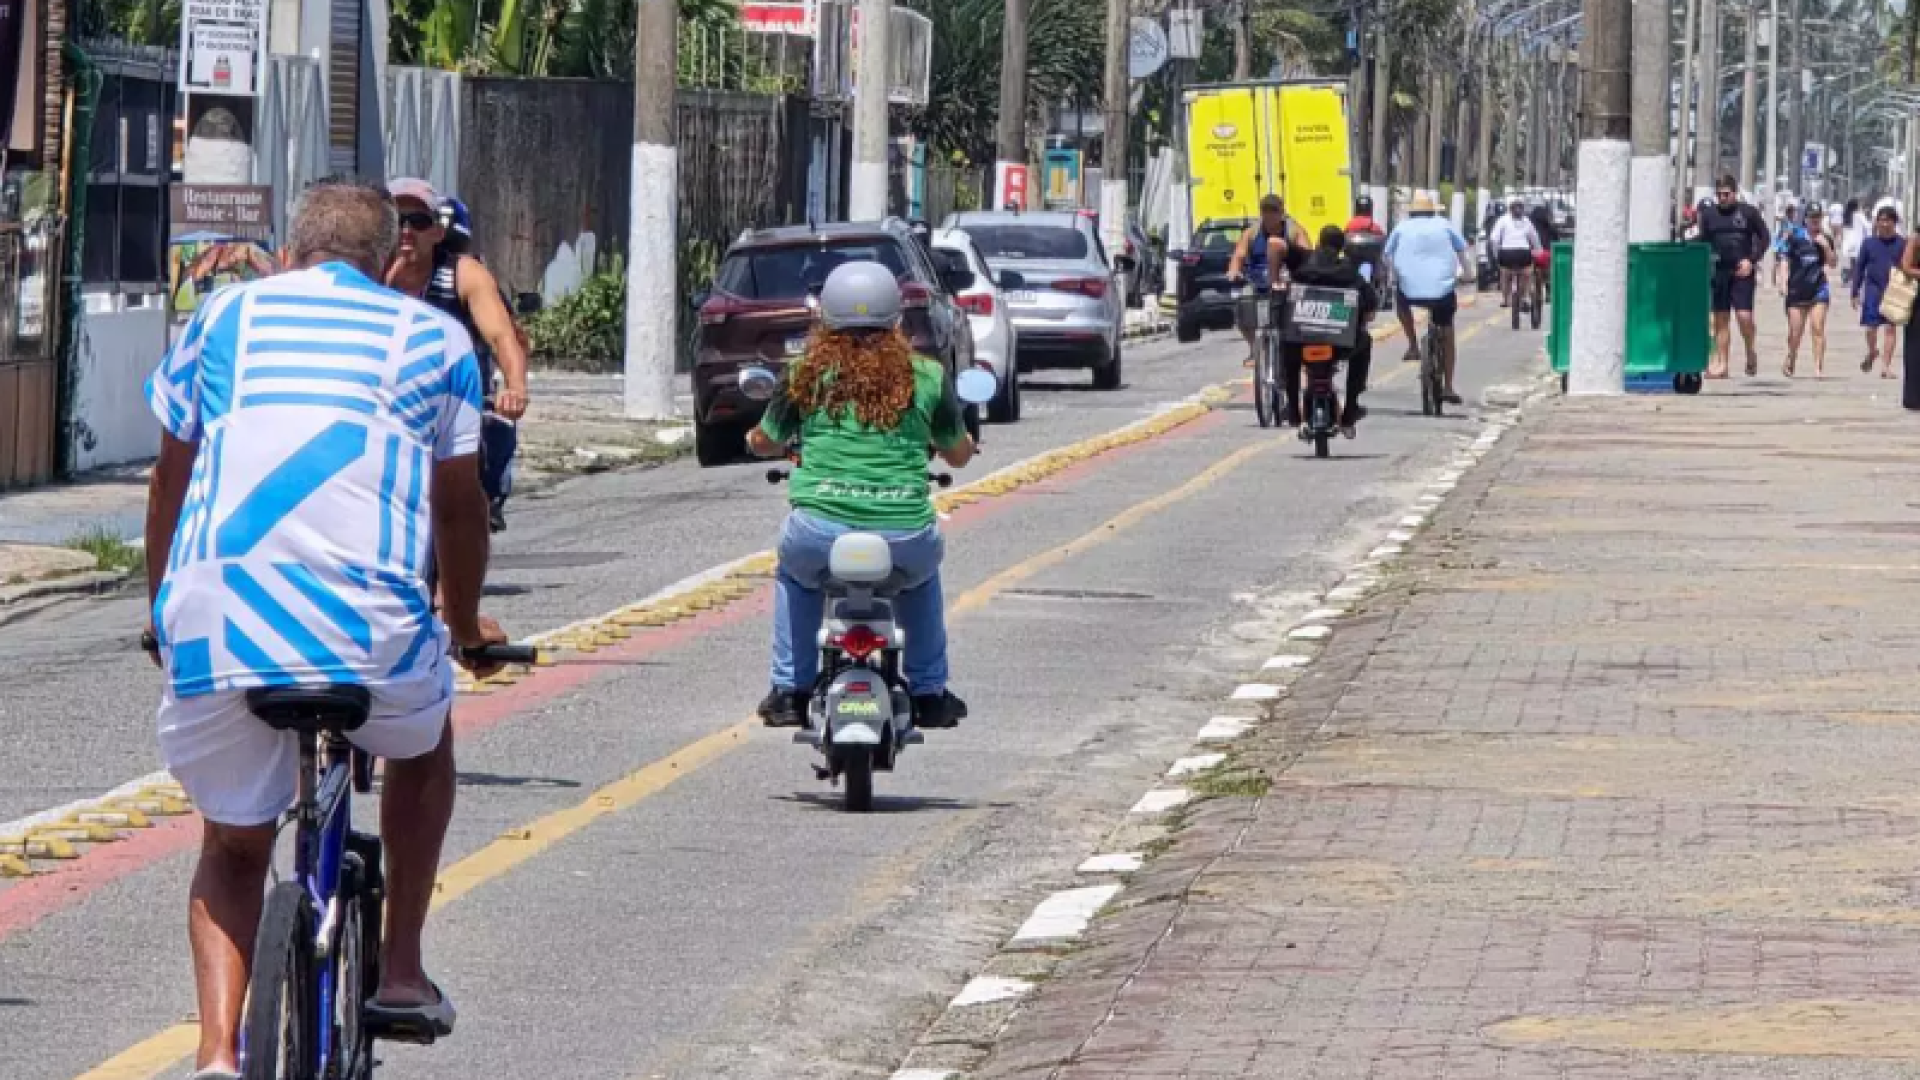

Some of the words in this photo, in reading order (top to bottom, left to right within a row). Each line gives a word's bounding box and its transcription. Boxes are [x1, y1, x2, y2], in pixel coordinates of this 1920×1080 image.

[184, 188, 262, 204] Restaurante
[186, 205, 224, 221] Music
[237, 205, 259, 221] Bar
